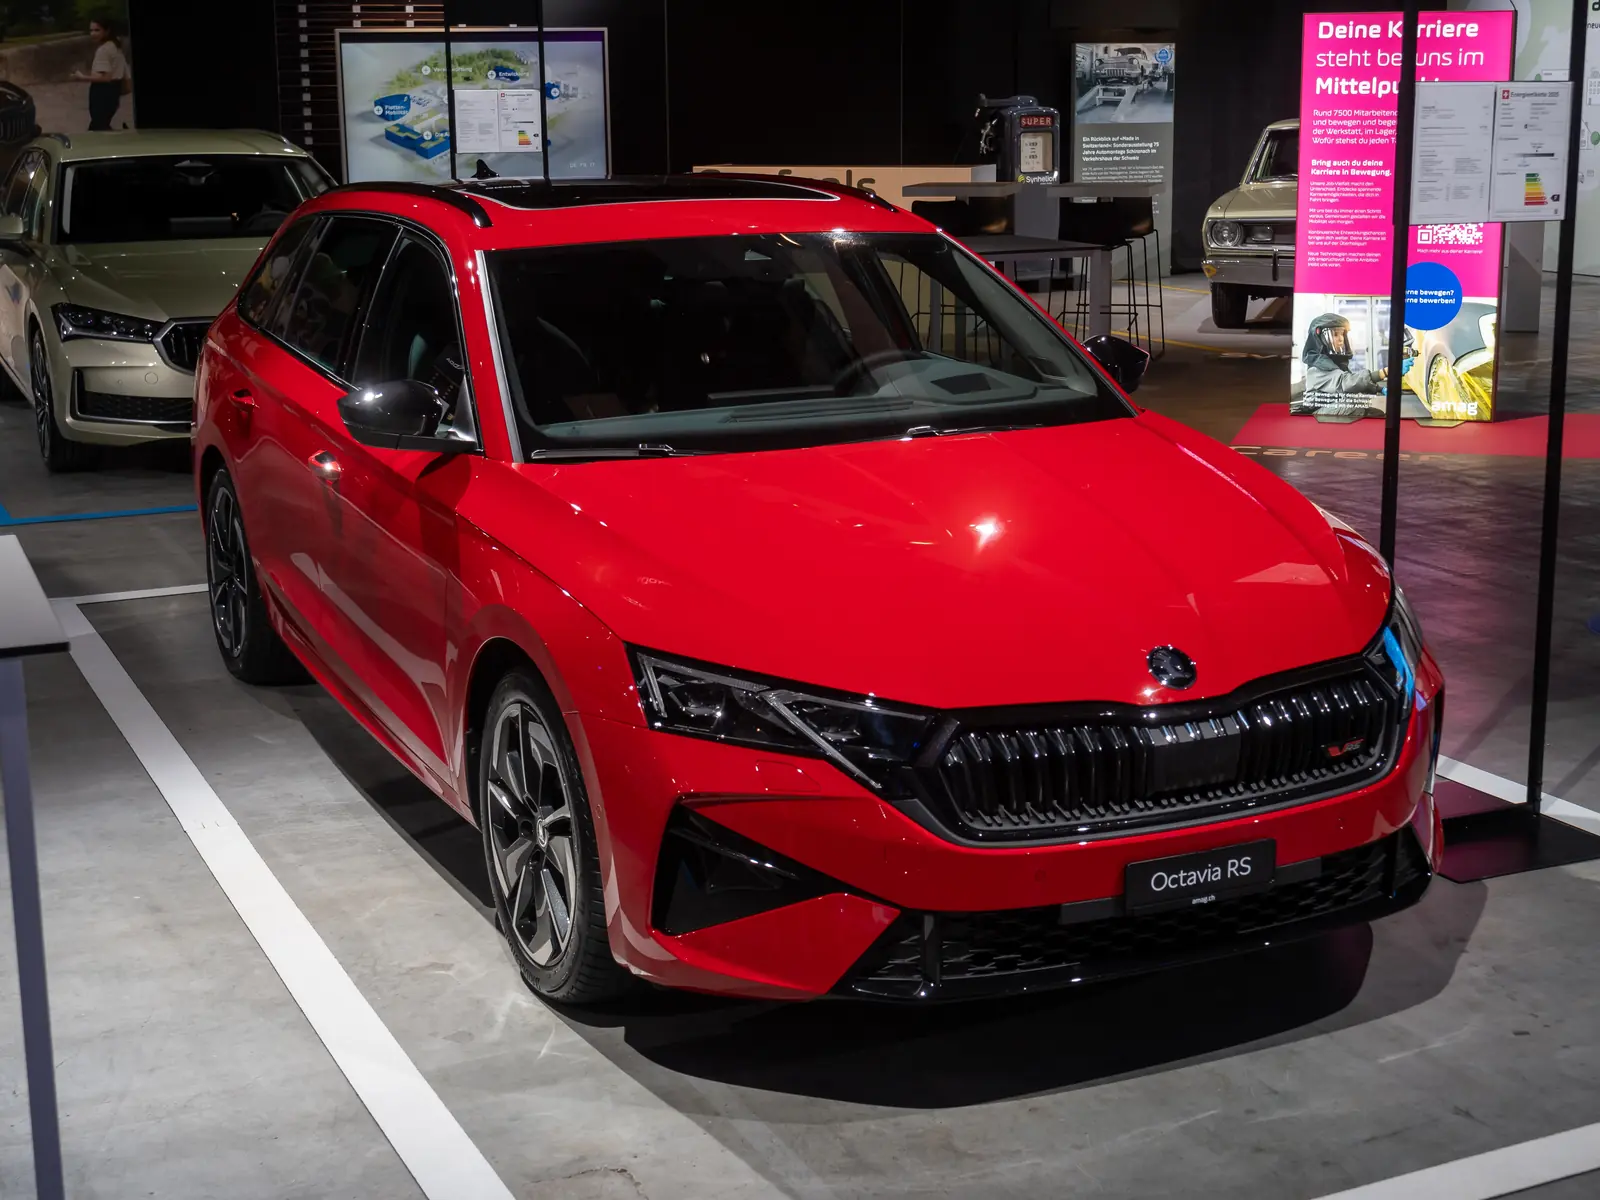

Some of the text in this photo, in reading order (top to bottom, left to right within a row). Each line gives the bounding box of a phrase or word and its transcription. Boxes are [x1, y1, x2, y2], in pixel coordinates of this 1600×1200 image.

[1318, 19, 1479, 39] Deine Krriere
[1315, 48, 1484, 67] steht be uns im
[1315, 77, 1440, 98] Mittelpu
[1021, 117, 1052, 126] SUPER
[1328, 119, 1361, 127] bewegen
[1375, 128, 1398, 136] Lager,
[1368, 137, 1390, 145] jeden
[1311, 159, 1331, 167] Bring
[1350, 169, 1392, 177] Bewegung.
[1419, 289, 1455, 297] bewegen?
[1431, 401, 1478, 416] amag
[1150, 856, 1252, 892] Octavia RS
[1191, 894, 1216, 905] amag.ch
